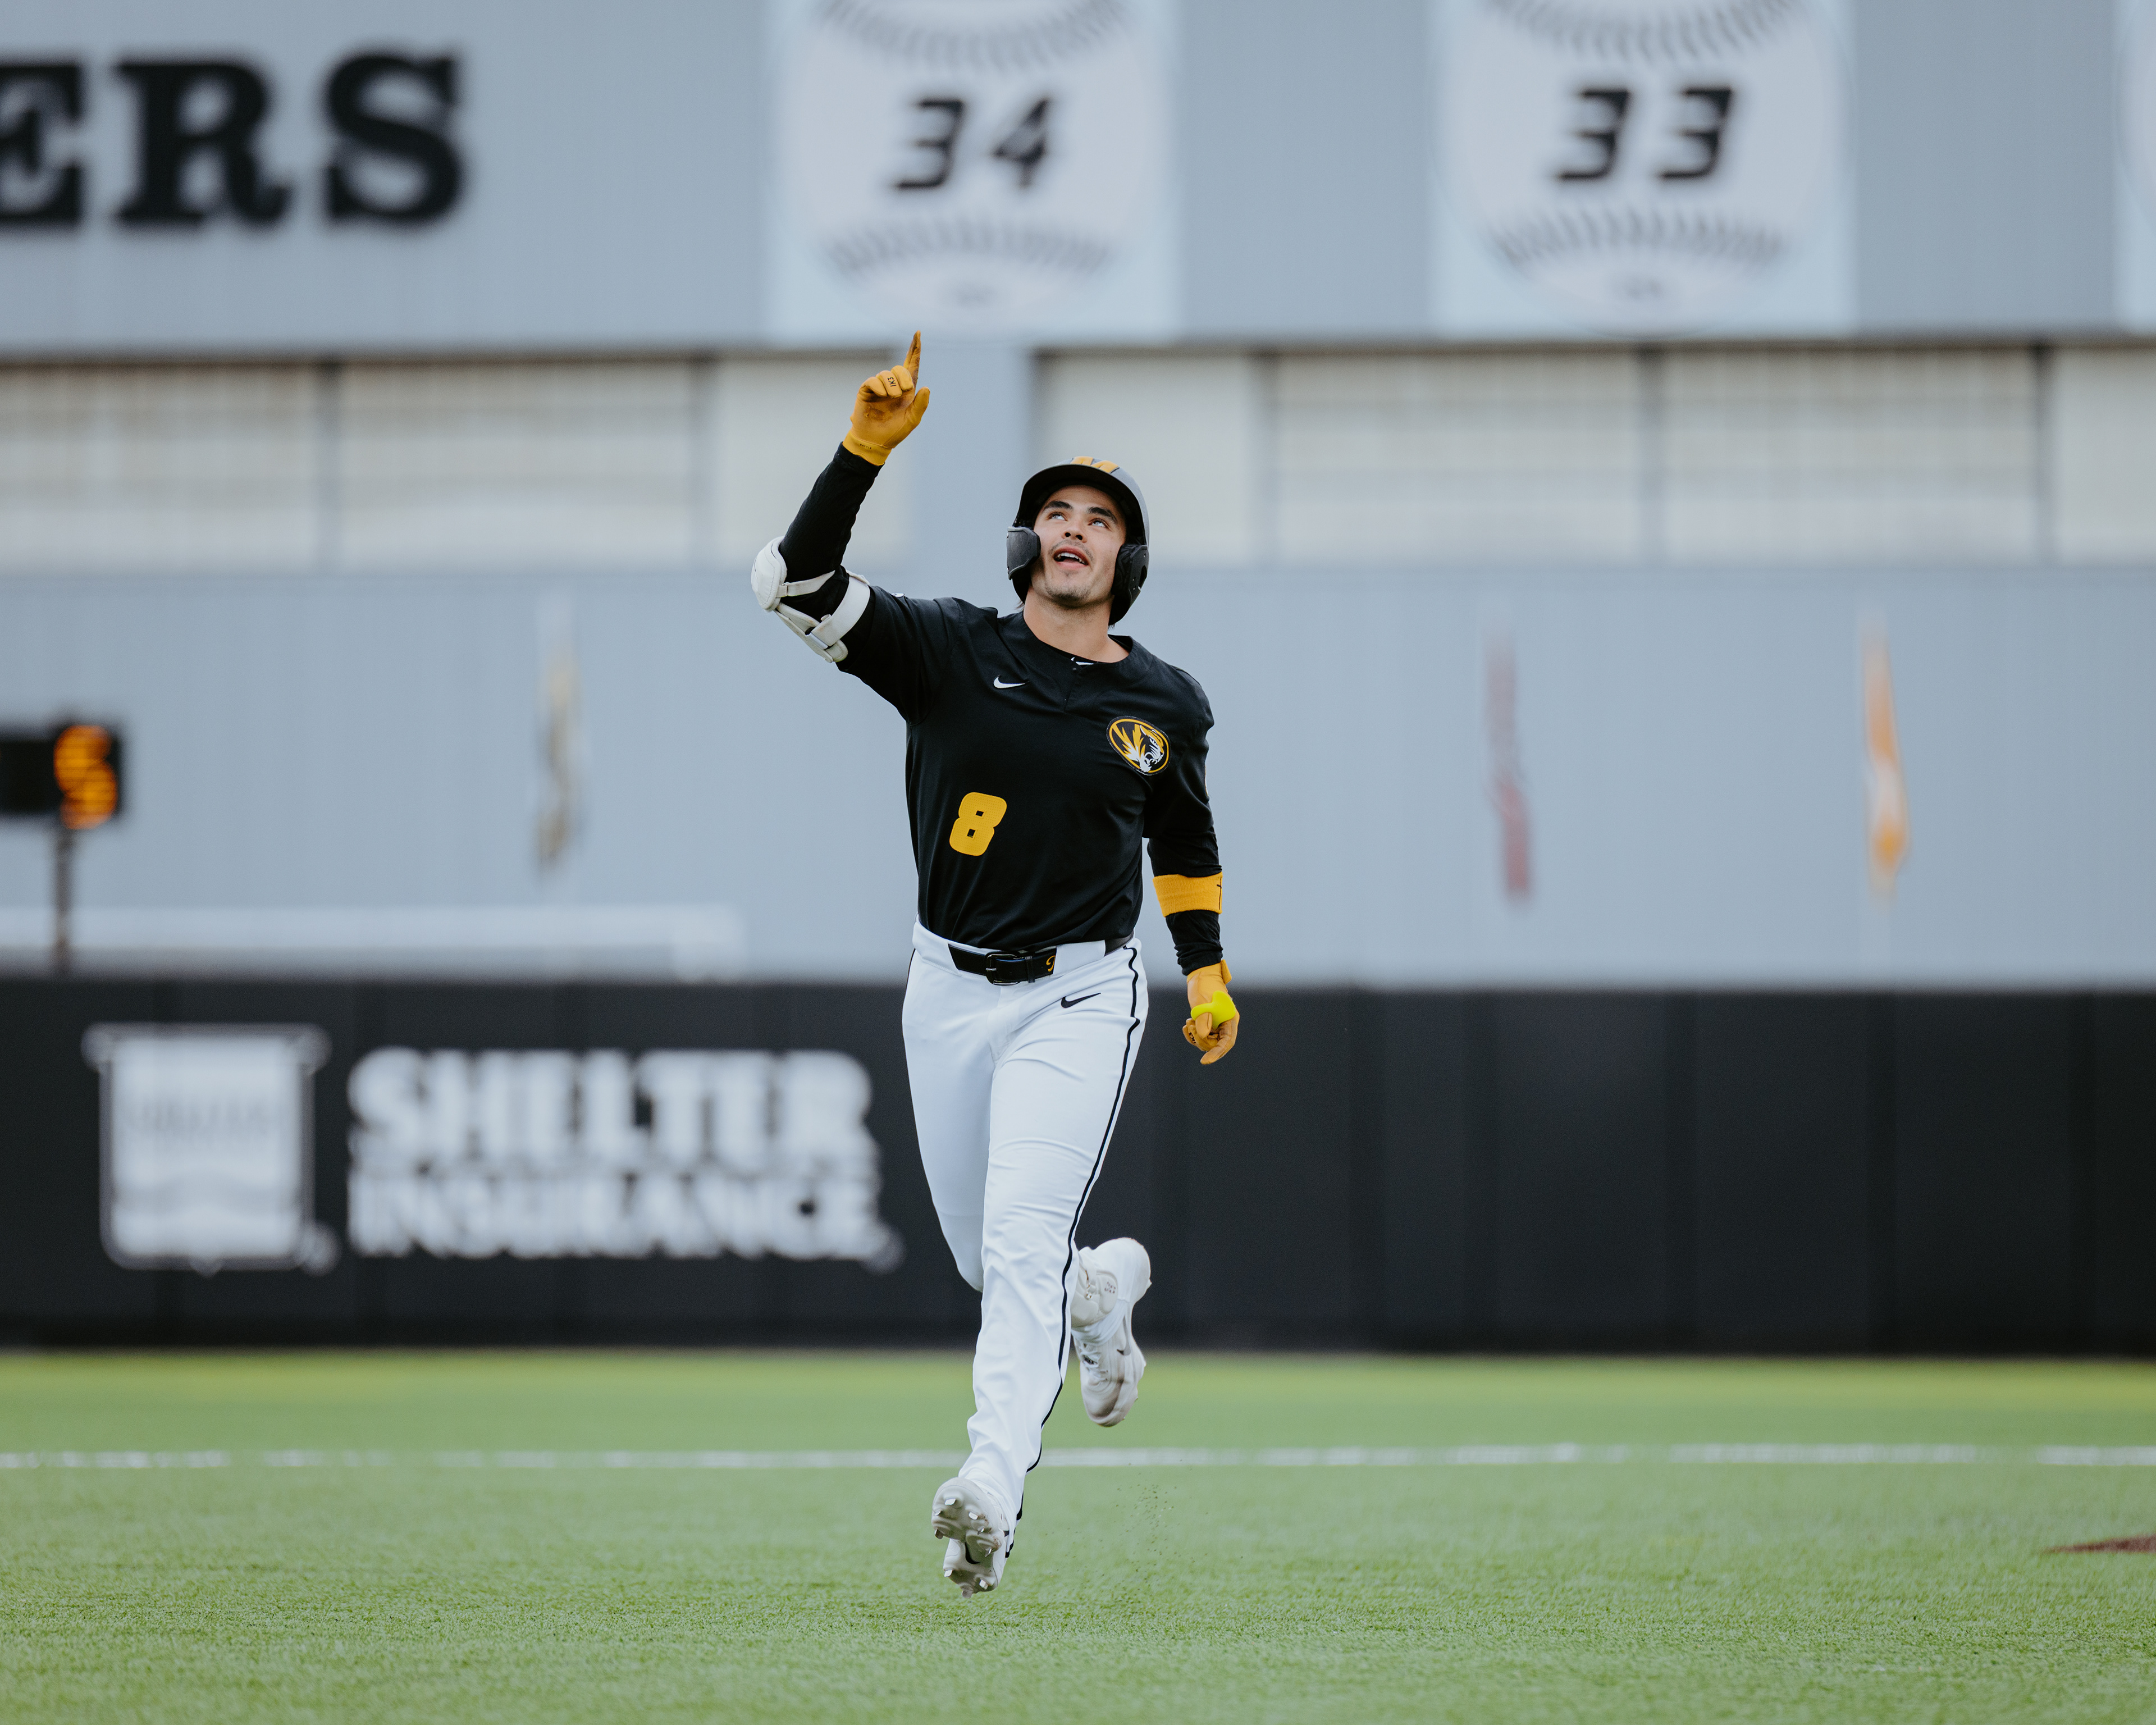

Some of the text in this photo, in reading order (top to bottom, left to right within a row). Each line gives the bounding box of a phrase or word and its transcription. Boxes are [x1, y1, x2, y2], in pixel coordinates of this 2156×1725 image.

[895, 97, 1050, 191] 34
[1559, 85, 1734, 182] 33
[949, 792, 1007, 856] 8
